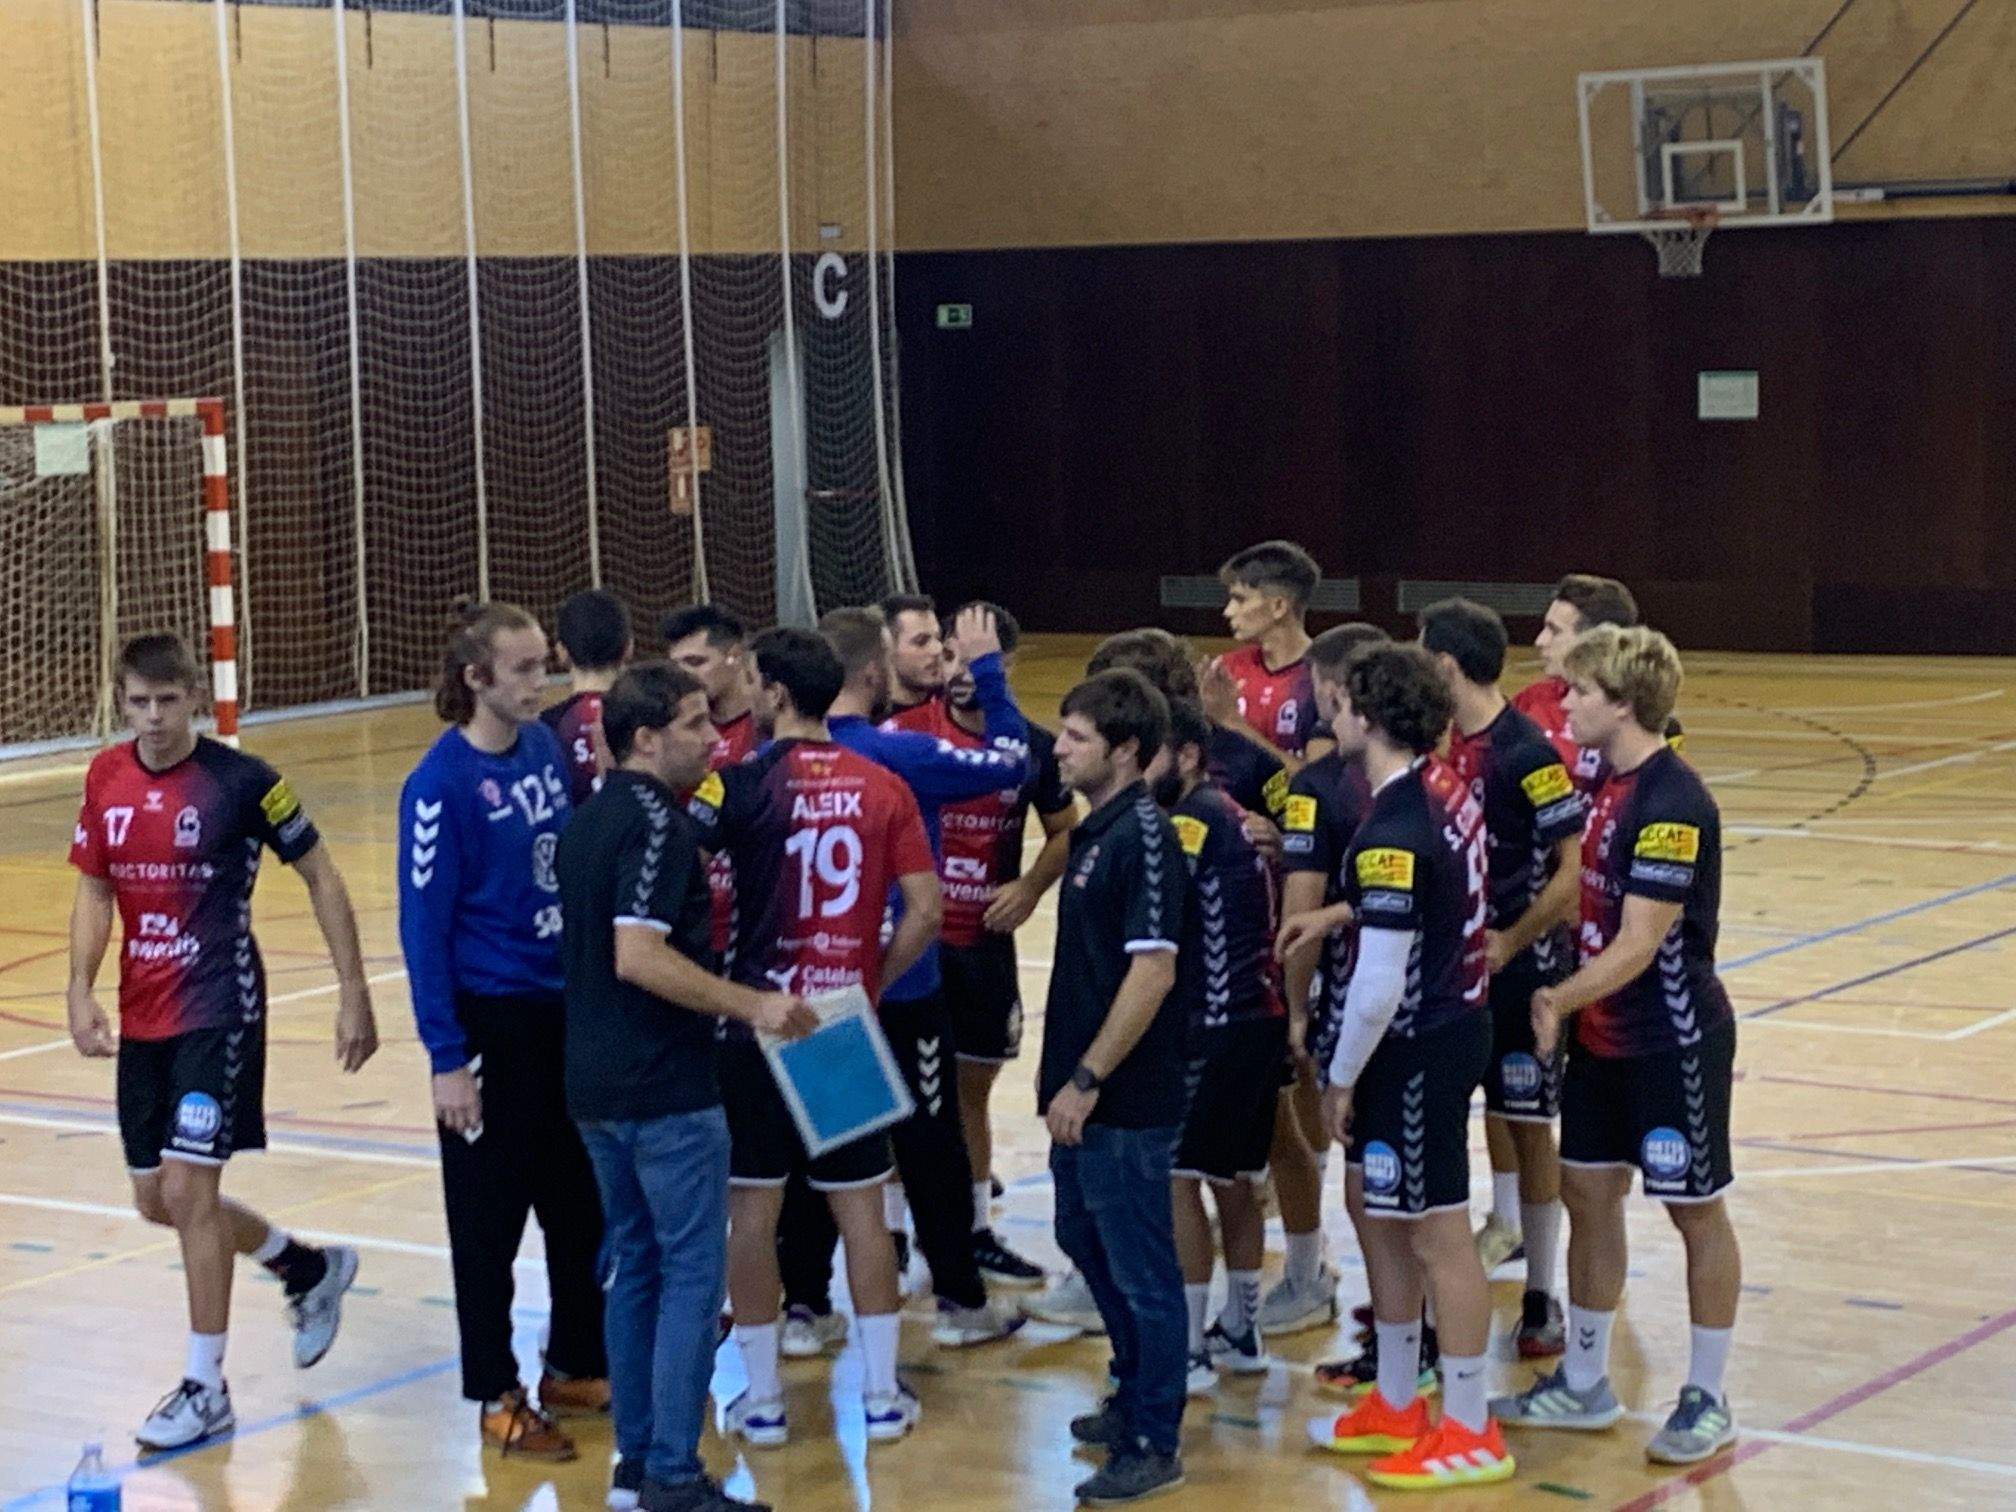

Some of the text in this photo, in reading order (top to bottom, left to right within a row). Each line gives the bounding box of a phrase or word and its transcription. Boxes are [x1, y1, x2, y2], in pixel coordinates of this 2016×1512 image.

[813, 252, 848, 319] C
[103, 806, 135, 847] 17
[791, 790, 863, 821] ALEIX
[784, 824, 864, 919] 19
